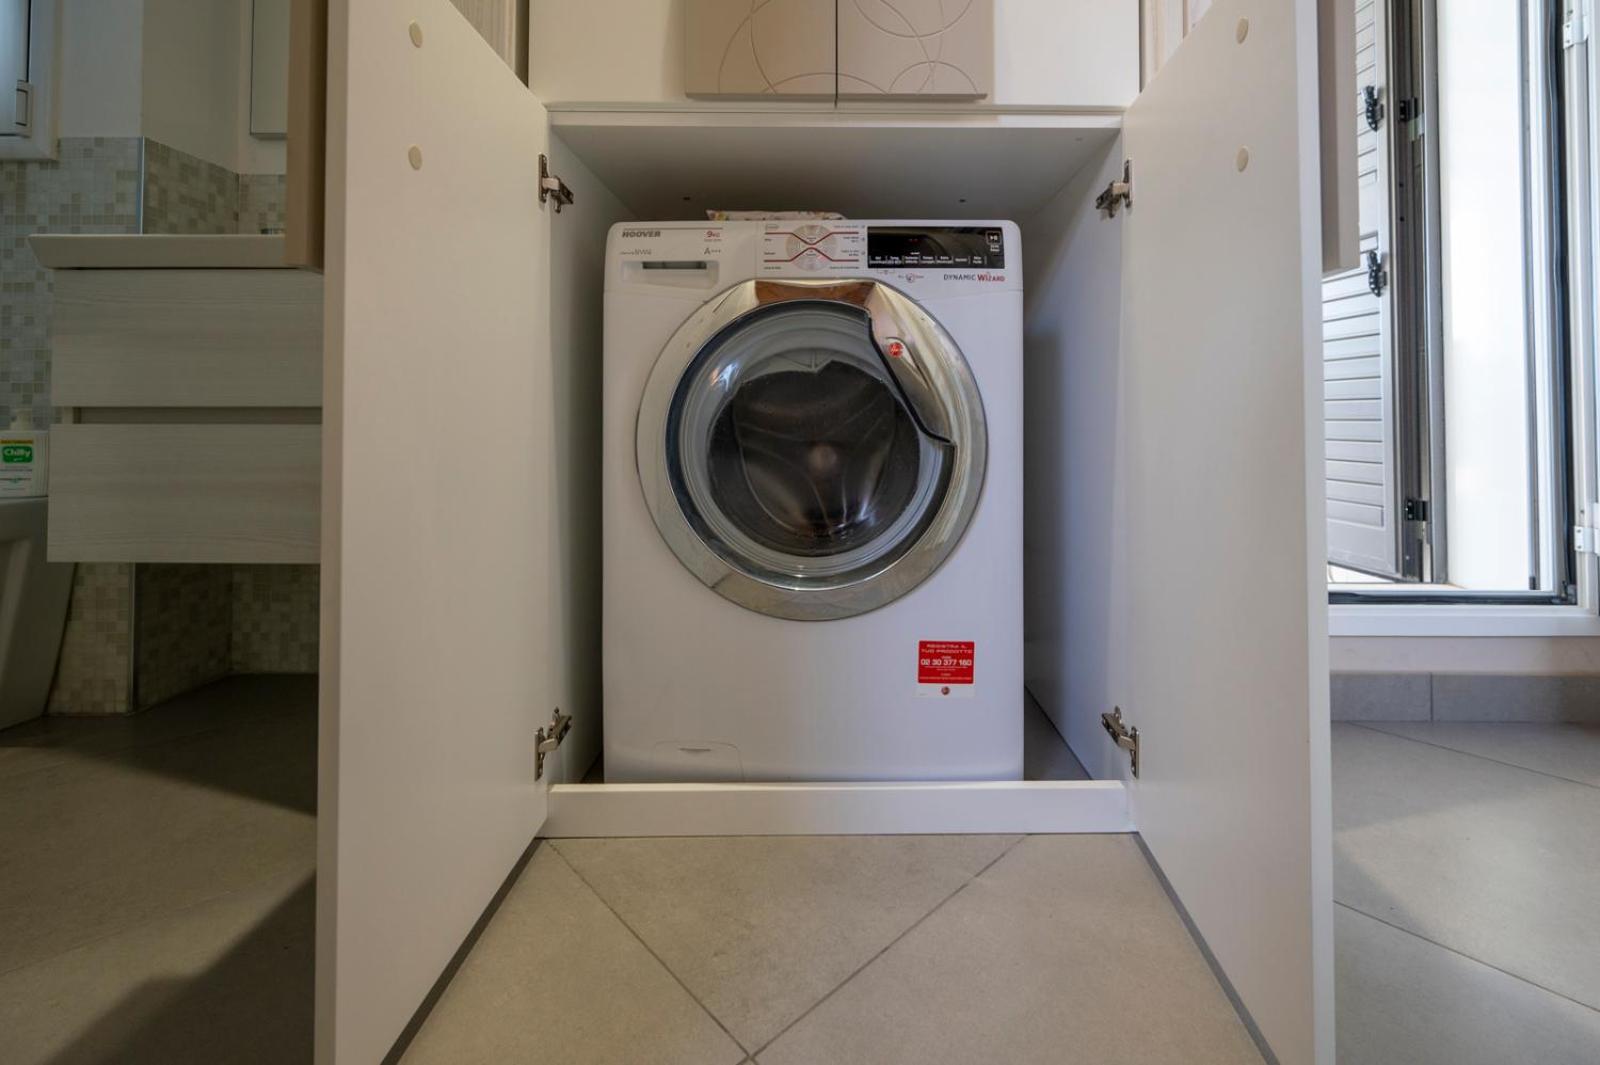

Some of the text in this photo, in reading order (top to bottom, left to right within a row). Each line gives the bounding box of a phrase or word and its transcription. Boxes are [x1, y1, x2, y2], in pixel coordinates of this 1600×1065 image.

[4, 448, 31, 458] Chilly
[932, 658, 942, 666] 30
[943, 658, 957, 666] 377
